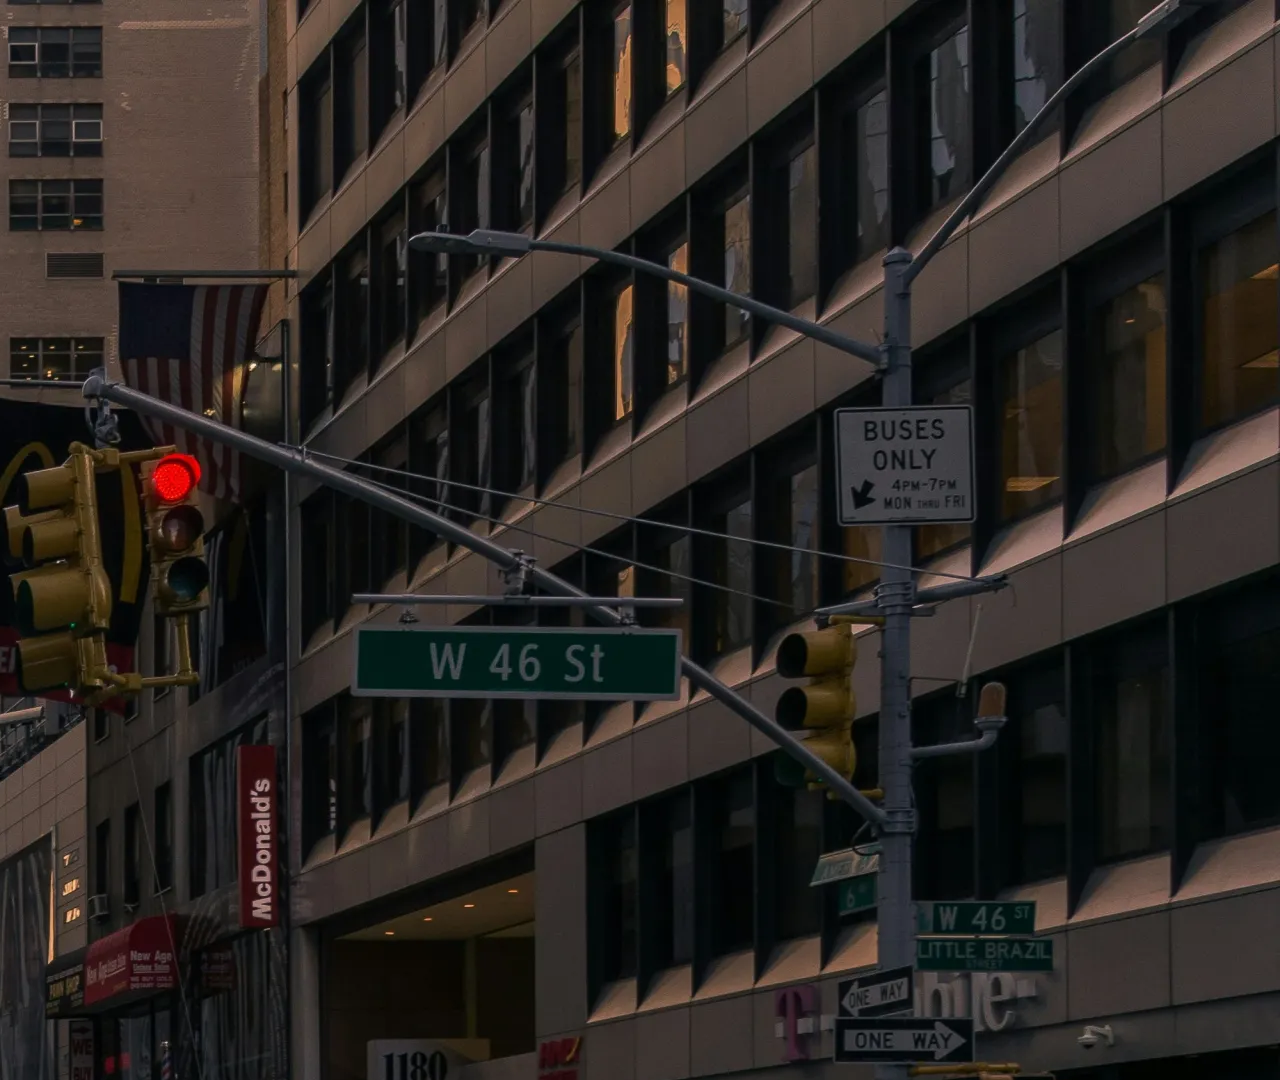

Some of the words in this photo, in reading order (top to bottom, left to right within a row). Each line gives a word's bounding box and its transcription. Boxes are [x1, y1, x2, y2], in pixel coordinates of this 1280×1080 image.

[864, 418, 945, 441] BUSES
[874, 449, 937, 471] ONLY
[892, 478, 957, 492] 4PM-7PM
[884, 496, 912, 510] MON
[918, 499, 940, 509] THRU
[945, 495, 966, 509] FRI
[429, 642, 466, 681] W
[488, 643, 541, 682] 46
[564, 643, 605, 683] St
[250, 777, 273, 921] McDonald's
[939, 905, 958, 931] W
[971, 905, 1006, 931] 46
[1014, 905, 1030, 919] ST
[130, 950, 151, 962] New
[154, 949, 172, 964] Age
[917, 941, 975, 959] LITTLE
[985, 942, 1051, 960] BRAZIL
[848, 988, 870, 1009] ONE
[880, 981, 905, 1003] WAY
[72, 1038, 92, 1055] WE
[854, 1031, 894, 1050] ONE
[912, 1031, 956, 1050] WAY
